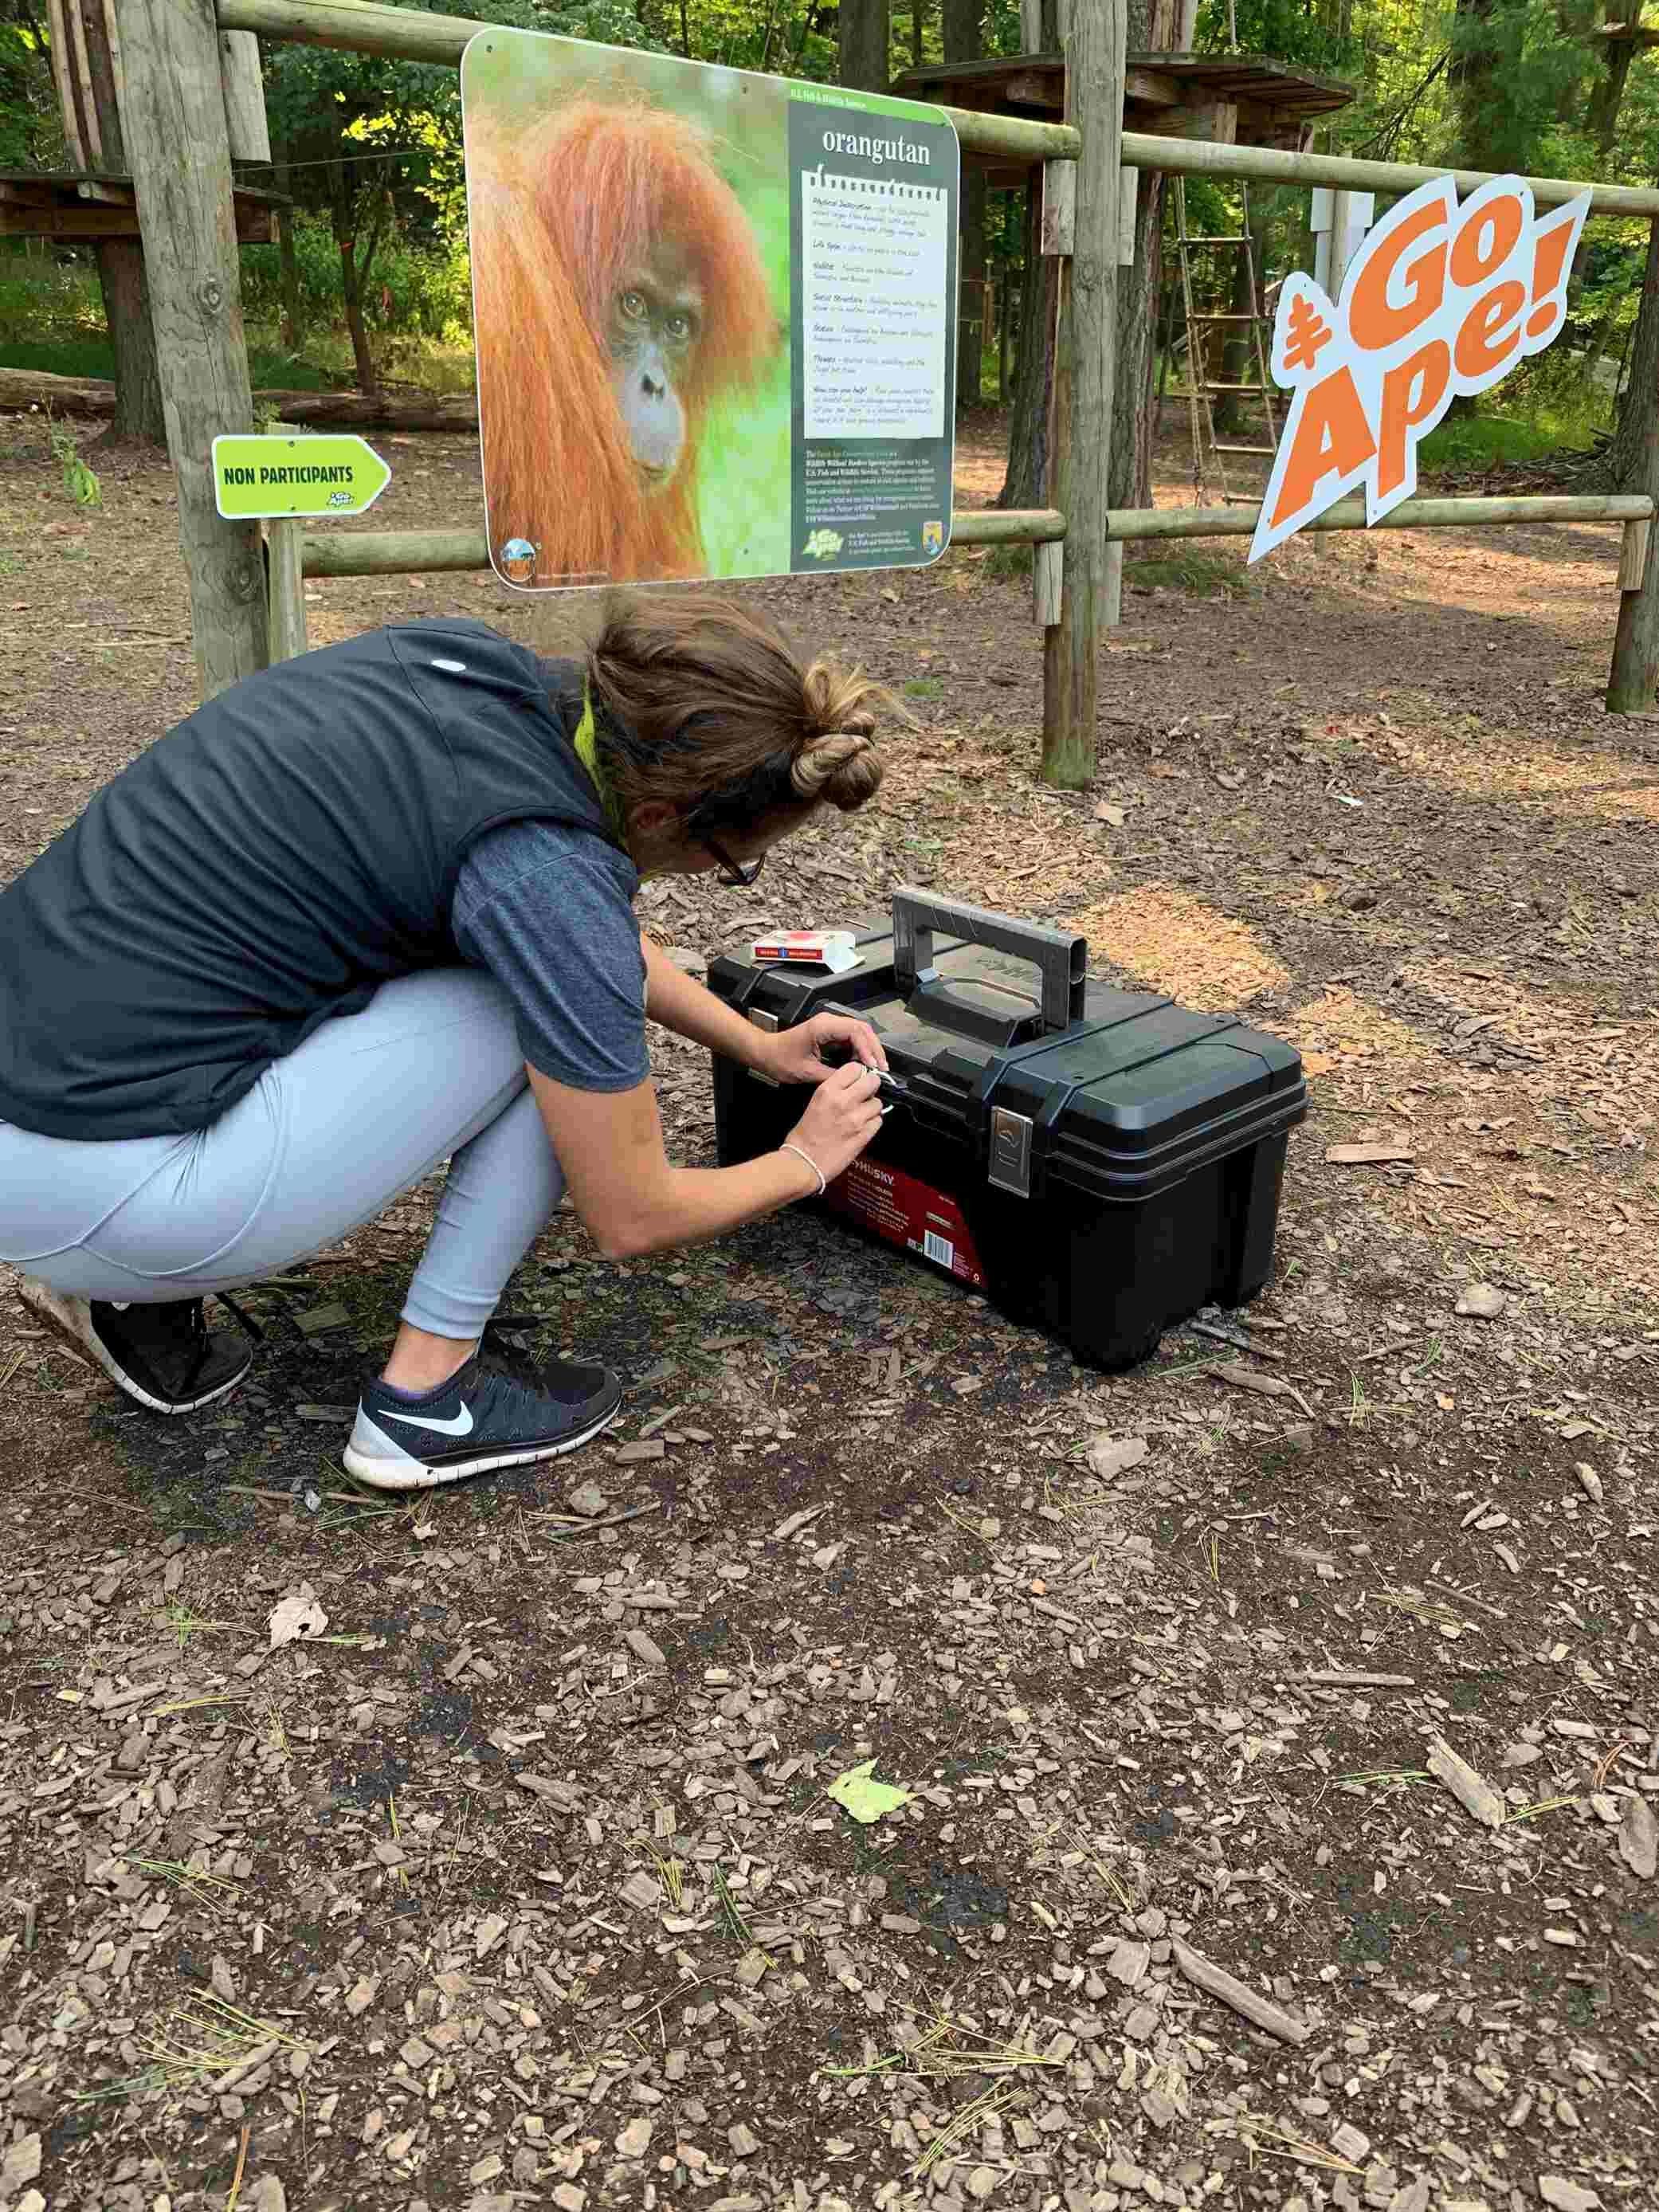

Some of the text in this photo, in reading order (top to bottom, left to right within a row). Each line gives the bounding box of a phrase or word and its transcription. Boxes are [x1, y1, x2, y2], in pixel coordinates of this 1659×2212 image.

[822, 131, 931, 165] orangutan
[1348, 194, 1524, 351] Go
[1269, 215, 1577, 531] Ape!
[224, 466, 353, 485] NON PARTICIPANTS
[860, 1161, 894, 1186] HUSKY
